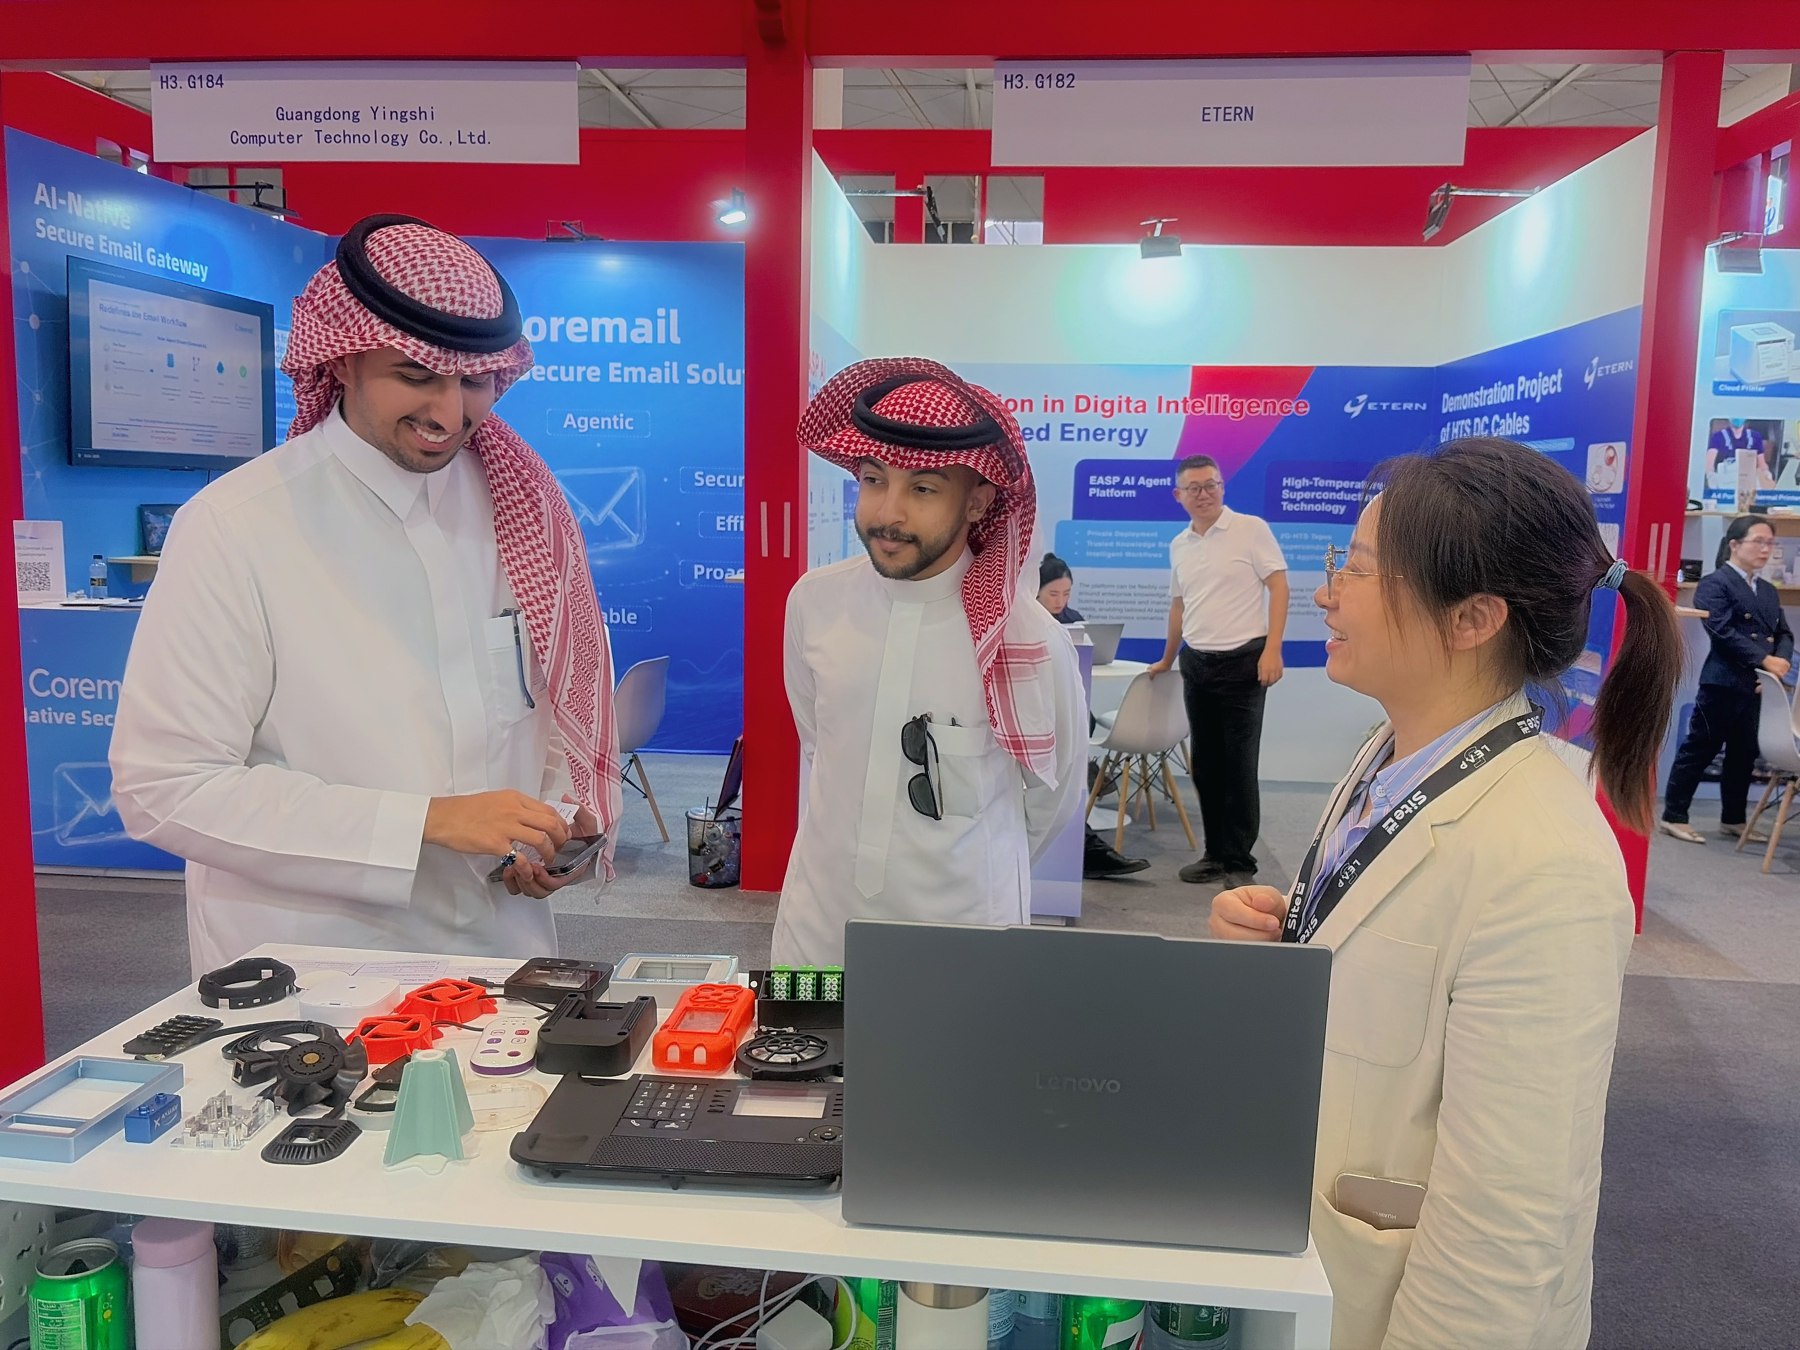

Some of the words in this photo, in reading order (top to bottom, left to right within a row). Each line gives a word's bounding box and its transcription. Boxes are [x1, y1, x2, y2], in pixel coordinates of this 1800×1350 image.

[275, 106, 361, 123] Guangdong
[370, 106, 435, 123] Yingshi
[1201, 106, 1254, 122] ETERN
[230, 130, 303, 147] Computer
[314, 129, 408, 147] Technology
[419, 129, 491, 147] Co.,Ltd.
[34, 182, 131, 230] AI-Native
[35, 218, 94, 250] Secure
[98, 235, 143, 263] Email
[146, 247, 208, 283] Gateway
[523, 308, 681, 345] oremail
[608, 361, 679, 384] Email
[686, 363, 744, 386] Solu
[1597, 360, 1633, 377] ETERN
[1442, 381, 1515, 414] Demonstration
[1516, 368, 1563, 403] Project
[1719, 384, 1740, 392] Cloud
[1043, 394, 1064, 413] in
[1074, 394, 1147, 419] Digita
[1157, 394, 1310, 421] Intelligence
[1367, 401, 1427, 411] ETERN
[563, 413, 634, 433] Agentic
[1021, 423, 1050, 442] ed
[1060, 423, 1148, 447] Energy
[1440, 421, 1452, 443] of
[1451, 418, 1472, 440] HTS
[1490, 411, 1530, 437] Cables
[1088, 487, 1137, 498] Platform
[1089, 476, 1120, 486] EASP
[1122, 476, 1135, 486] AI
[1137, 476, 1172, 488] Agent
[1281, 502, 1346, 515] Technology
[29, 668, 121, 700] Corem
[24, 707, 76, 725] ative
[81, 709, 114, 726] Sec
[1460, 744, 1491, 769] LEAP
[1394, 790, 1427, 820] Site
[1338, 859, 1361, 888] LEAP
[1287, 896, 1302, 930] Site
[1034, 1072, 1121, 1093] Lenovo
